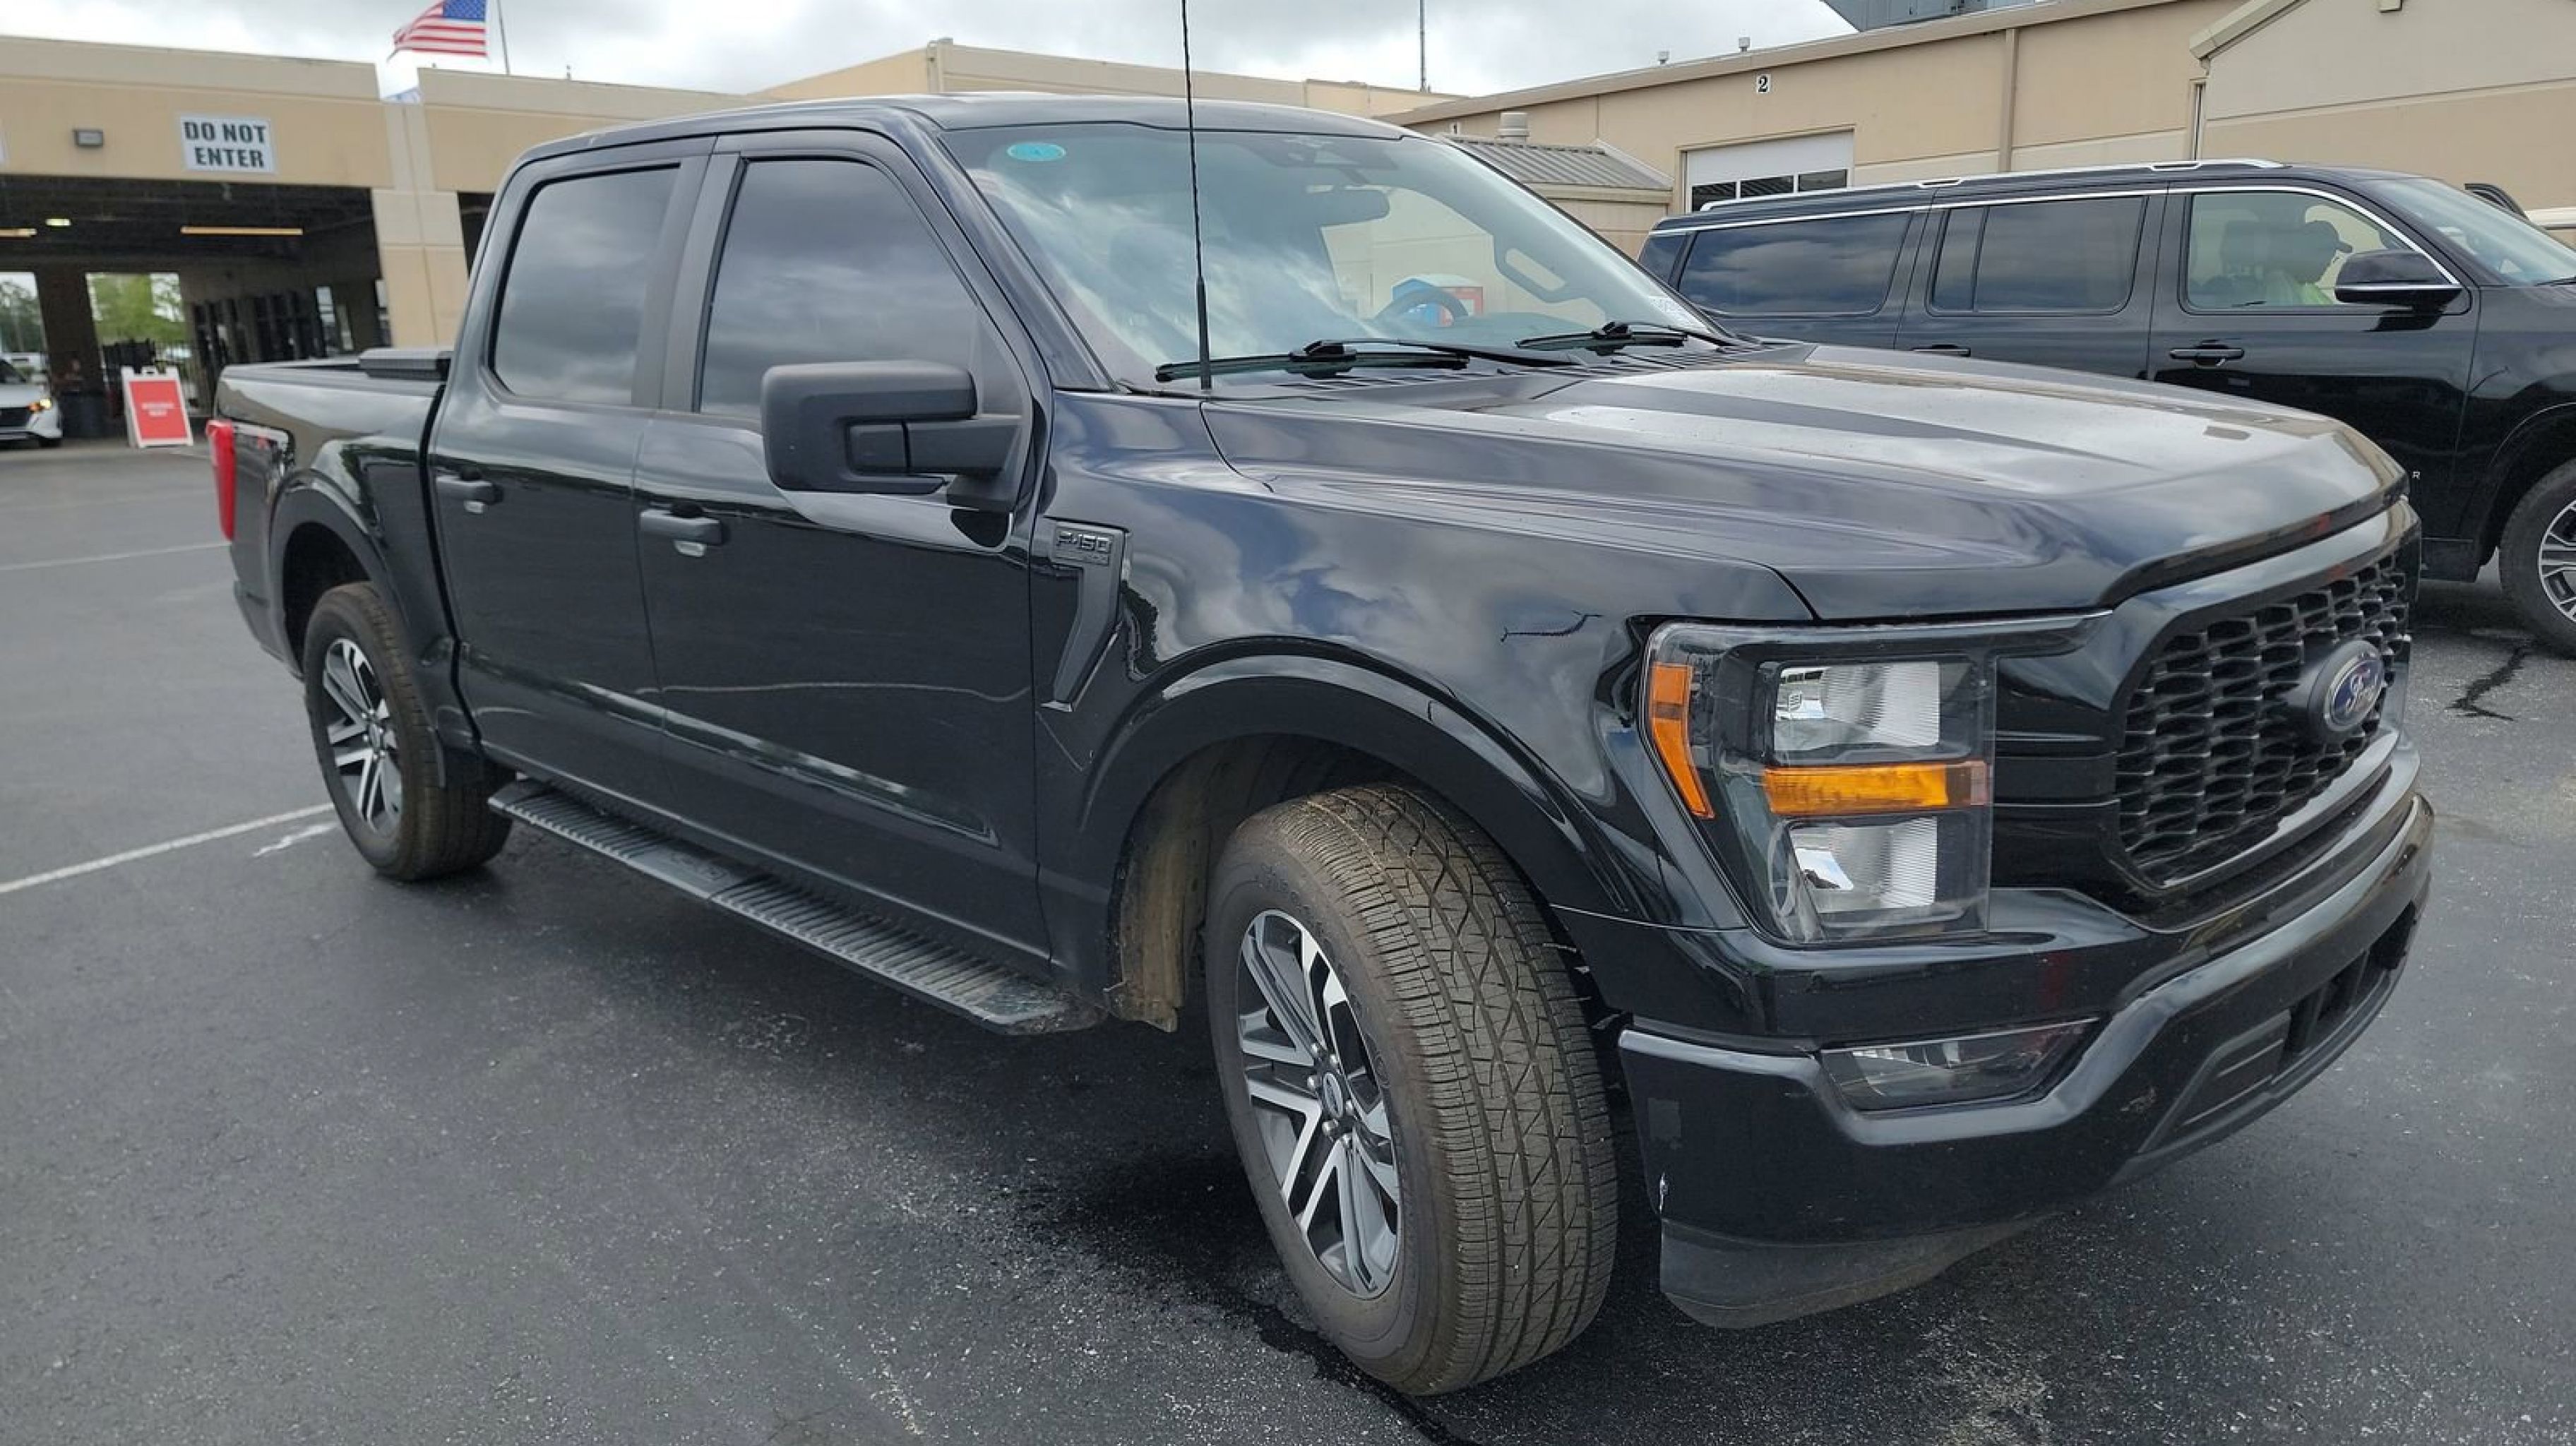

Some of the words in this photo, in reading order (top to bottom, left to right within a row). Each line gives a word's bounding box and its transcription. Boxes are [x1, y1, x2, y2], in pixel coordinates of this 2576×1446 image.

[1758, 75, 1768, 92] 2
[184, 121, 216, 141] DO
[222, 124, 266, 143] NOT
[194, 147, 265, 167] ENTER
